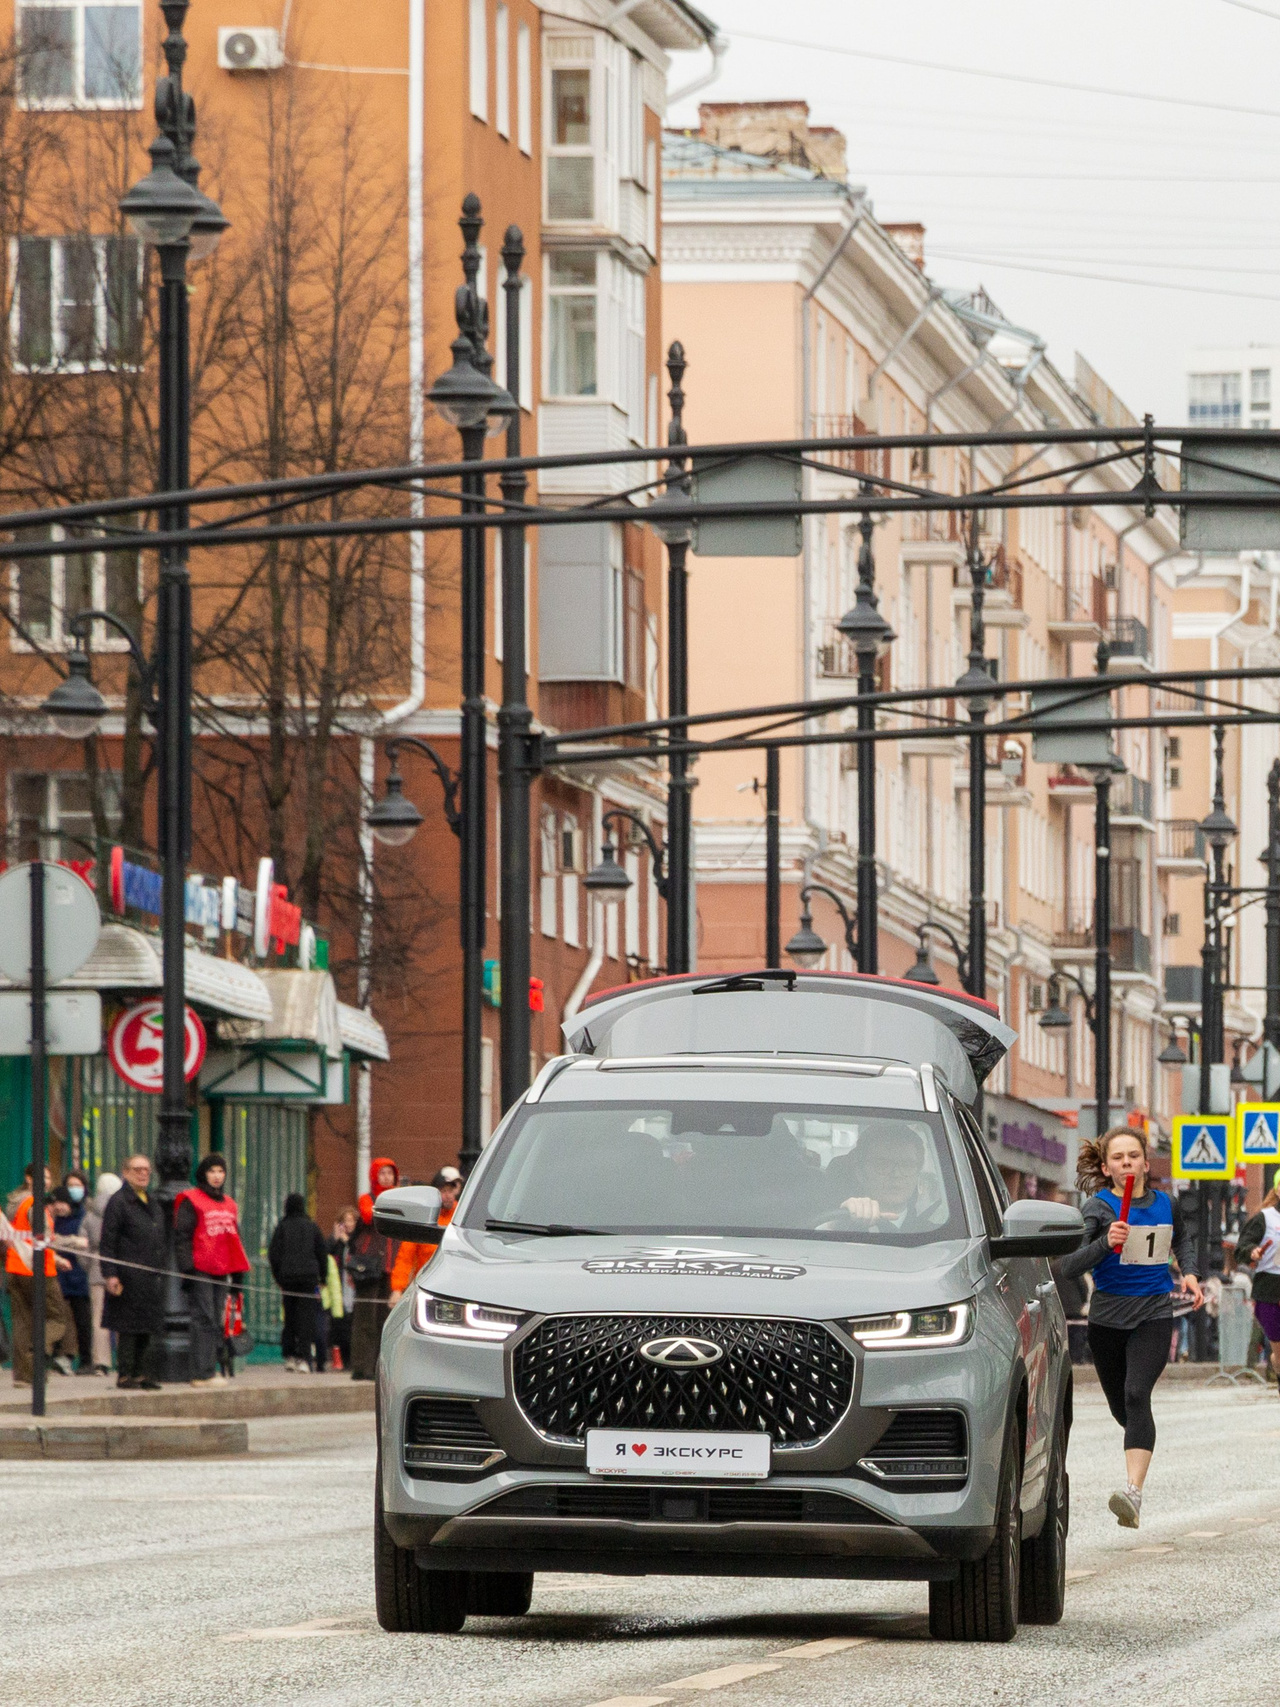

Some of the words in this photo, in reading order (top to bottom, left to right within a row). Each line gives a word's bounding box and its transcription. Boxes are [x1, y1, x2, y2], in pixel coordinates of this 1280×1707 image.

[1146, 1232, 1156, 1258] 1
[587, 1260, 801, 1275] ЭКСКУРС
[616, 1443, 626, 1456] Я
[653, 1447, 744, 1459] ЭКСКУРС
